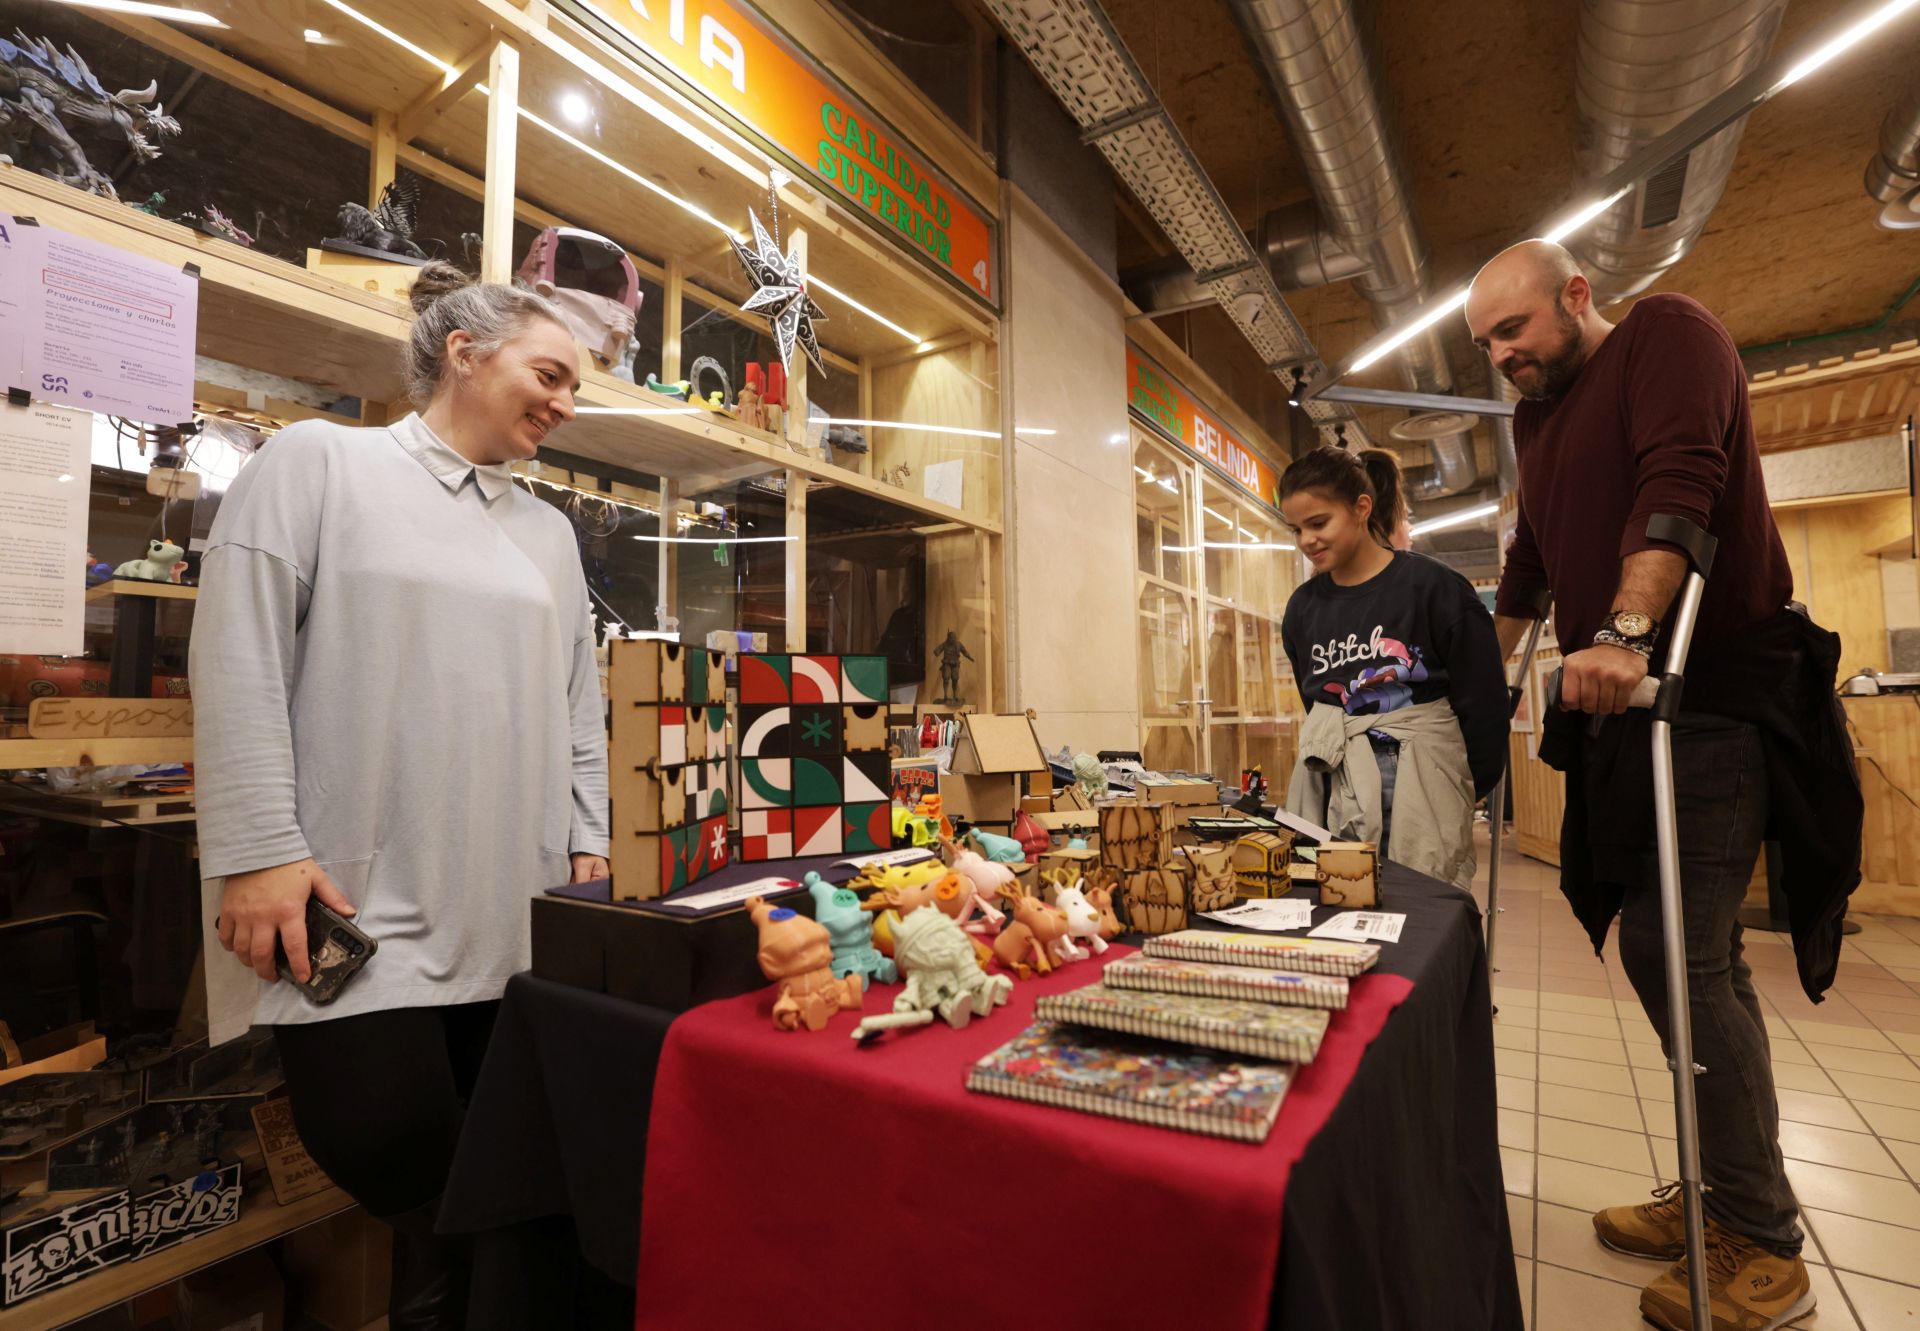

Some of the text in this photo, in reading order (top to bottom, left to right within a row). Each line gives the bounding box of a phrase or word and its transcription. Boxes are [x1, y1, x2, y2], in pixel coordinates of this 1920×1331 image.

[630, 0, 745, 94] IA
[820, 102, 951, 230] CALIDAD
[818, 140, 953, 267] SUPERIOR
[972, 259, 987, 292] 4
[46, 288, 120, 314] Proyecciones
[126, 310, 133, 318] y
[138, 312, 177, 329] charlas
[35, 412, 72, 423] SHORT CV
[147, 404, 171, 414] CreArt
[1133, 386, 1183, 438] SELECTAS
[1194, 414, 1260, 493] BELINDA
[1312, 625, 1392, 675] Stitch
[33, 699, 194, 736] Exposi
[1751, 1275, 1772, 1290] FILA
